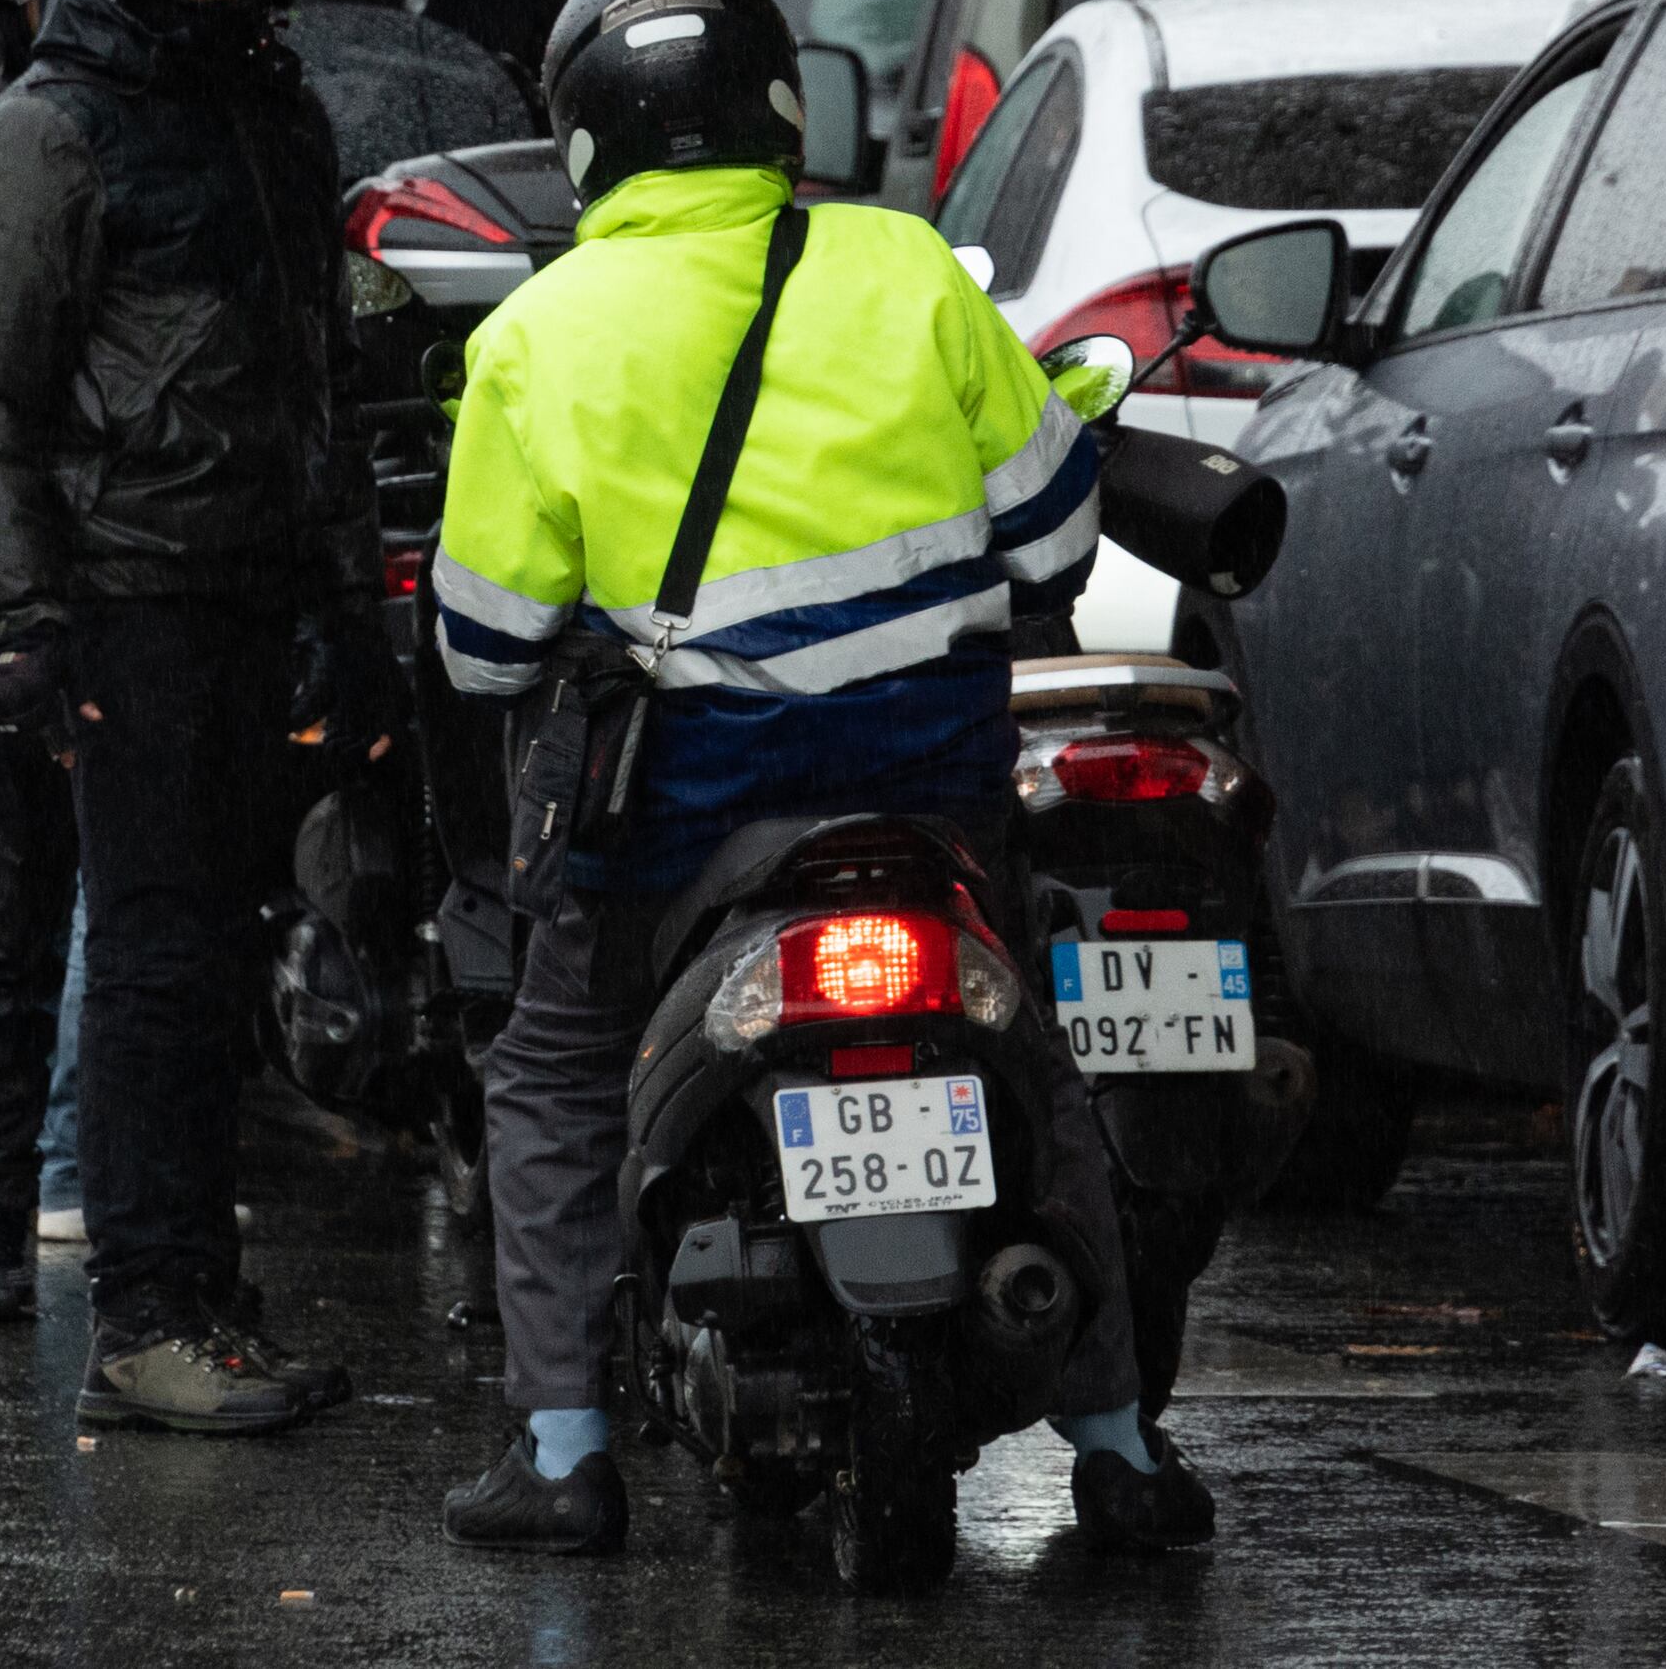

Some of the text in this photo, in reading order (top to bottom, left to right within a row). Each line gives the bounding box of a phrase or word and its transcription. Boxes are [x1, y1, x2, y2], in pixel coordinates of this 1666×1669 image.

[1101, 950, 1153, 992] DV
[1222, 974, 1247, 995] 45
[837, 1092, 893, 1135] GB
[952, 1107, 980, 1131] 75
[792, 1128, 803, 1143] F
